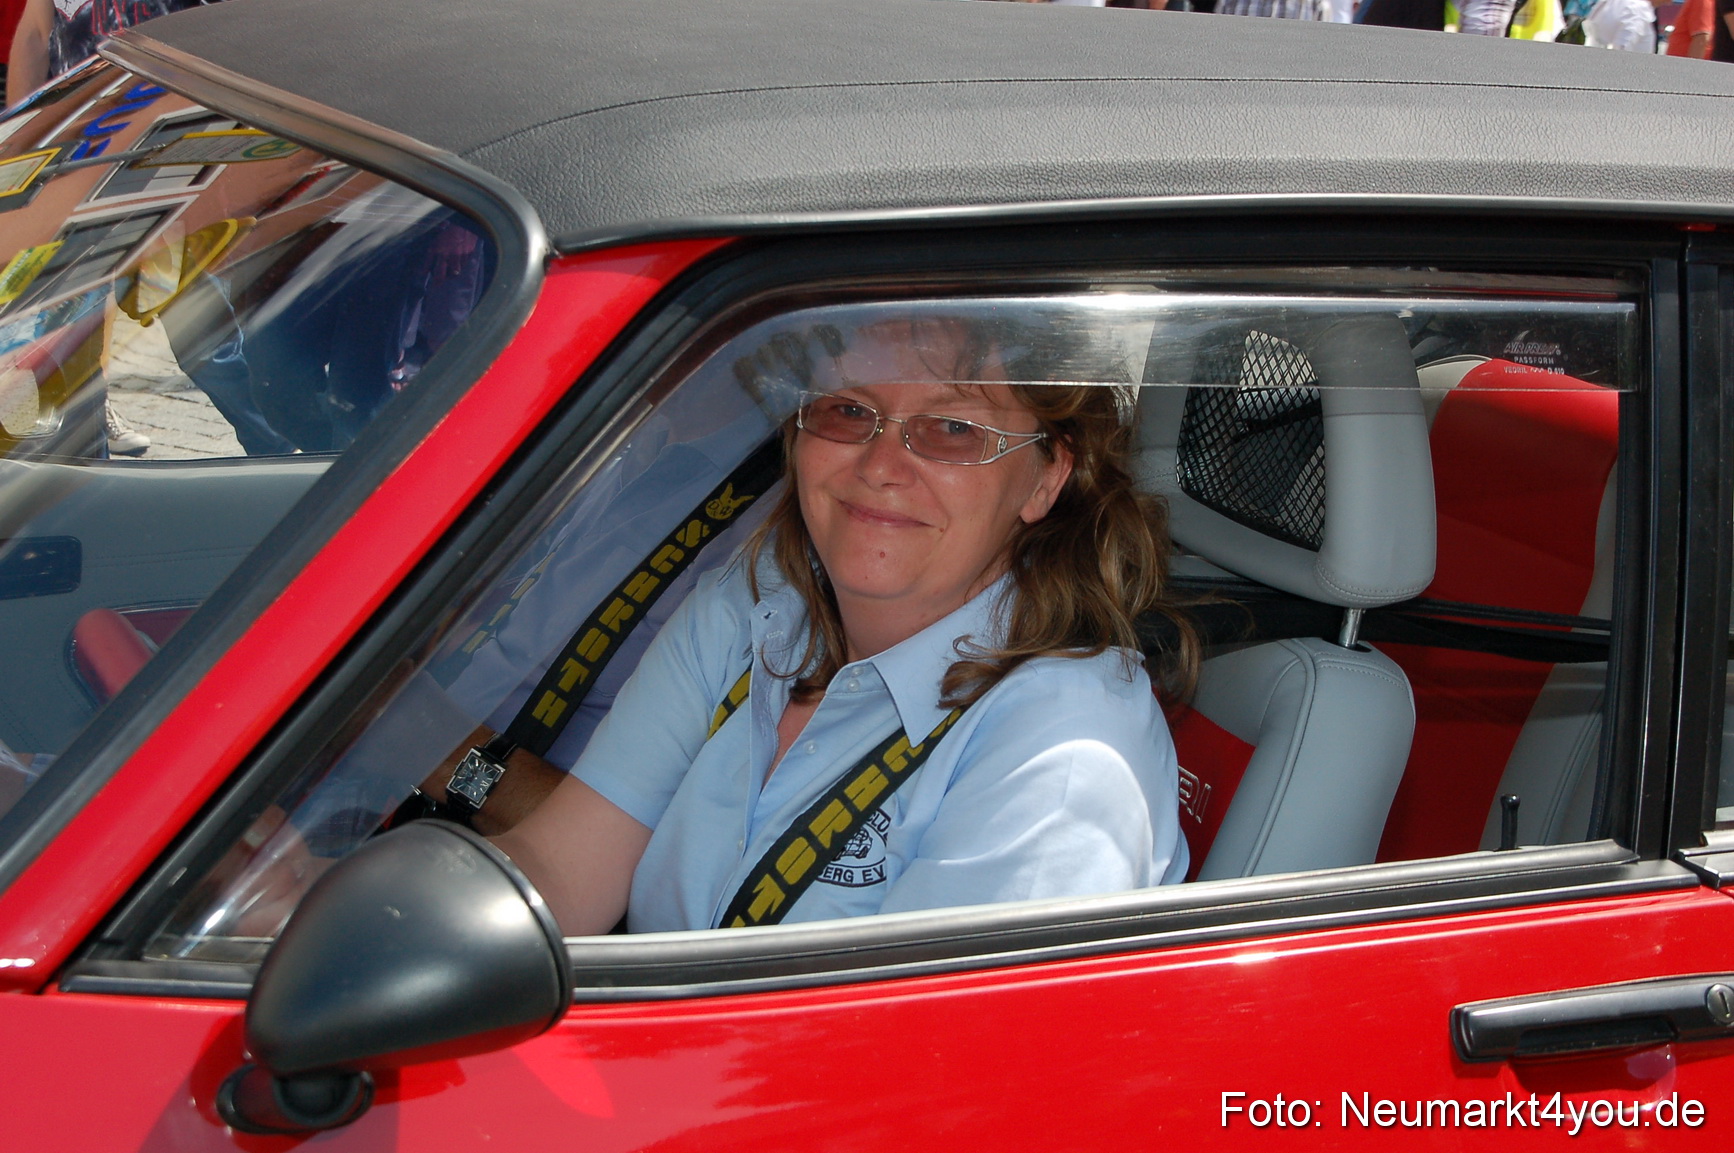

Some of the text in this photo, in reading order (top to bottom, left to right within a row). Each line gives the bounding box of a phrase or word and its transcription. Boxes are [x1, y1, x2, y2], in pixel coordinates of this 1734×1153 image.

[531, 519, 710, 727] SCHROTH
[819, 864, 884, 883] ERG EV
